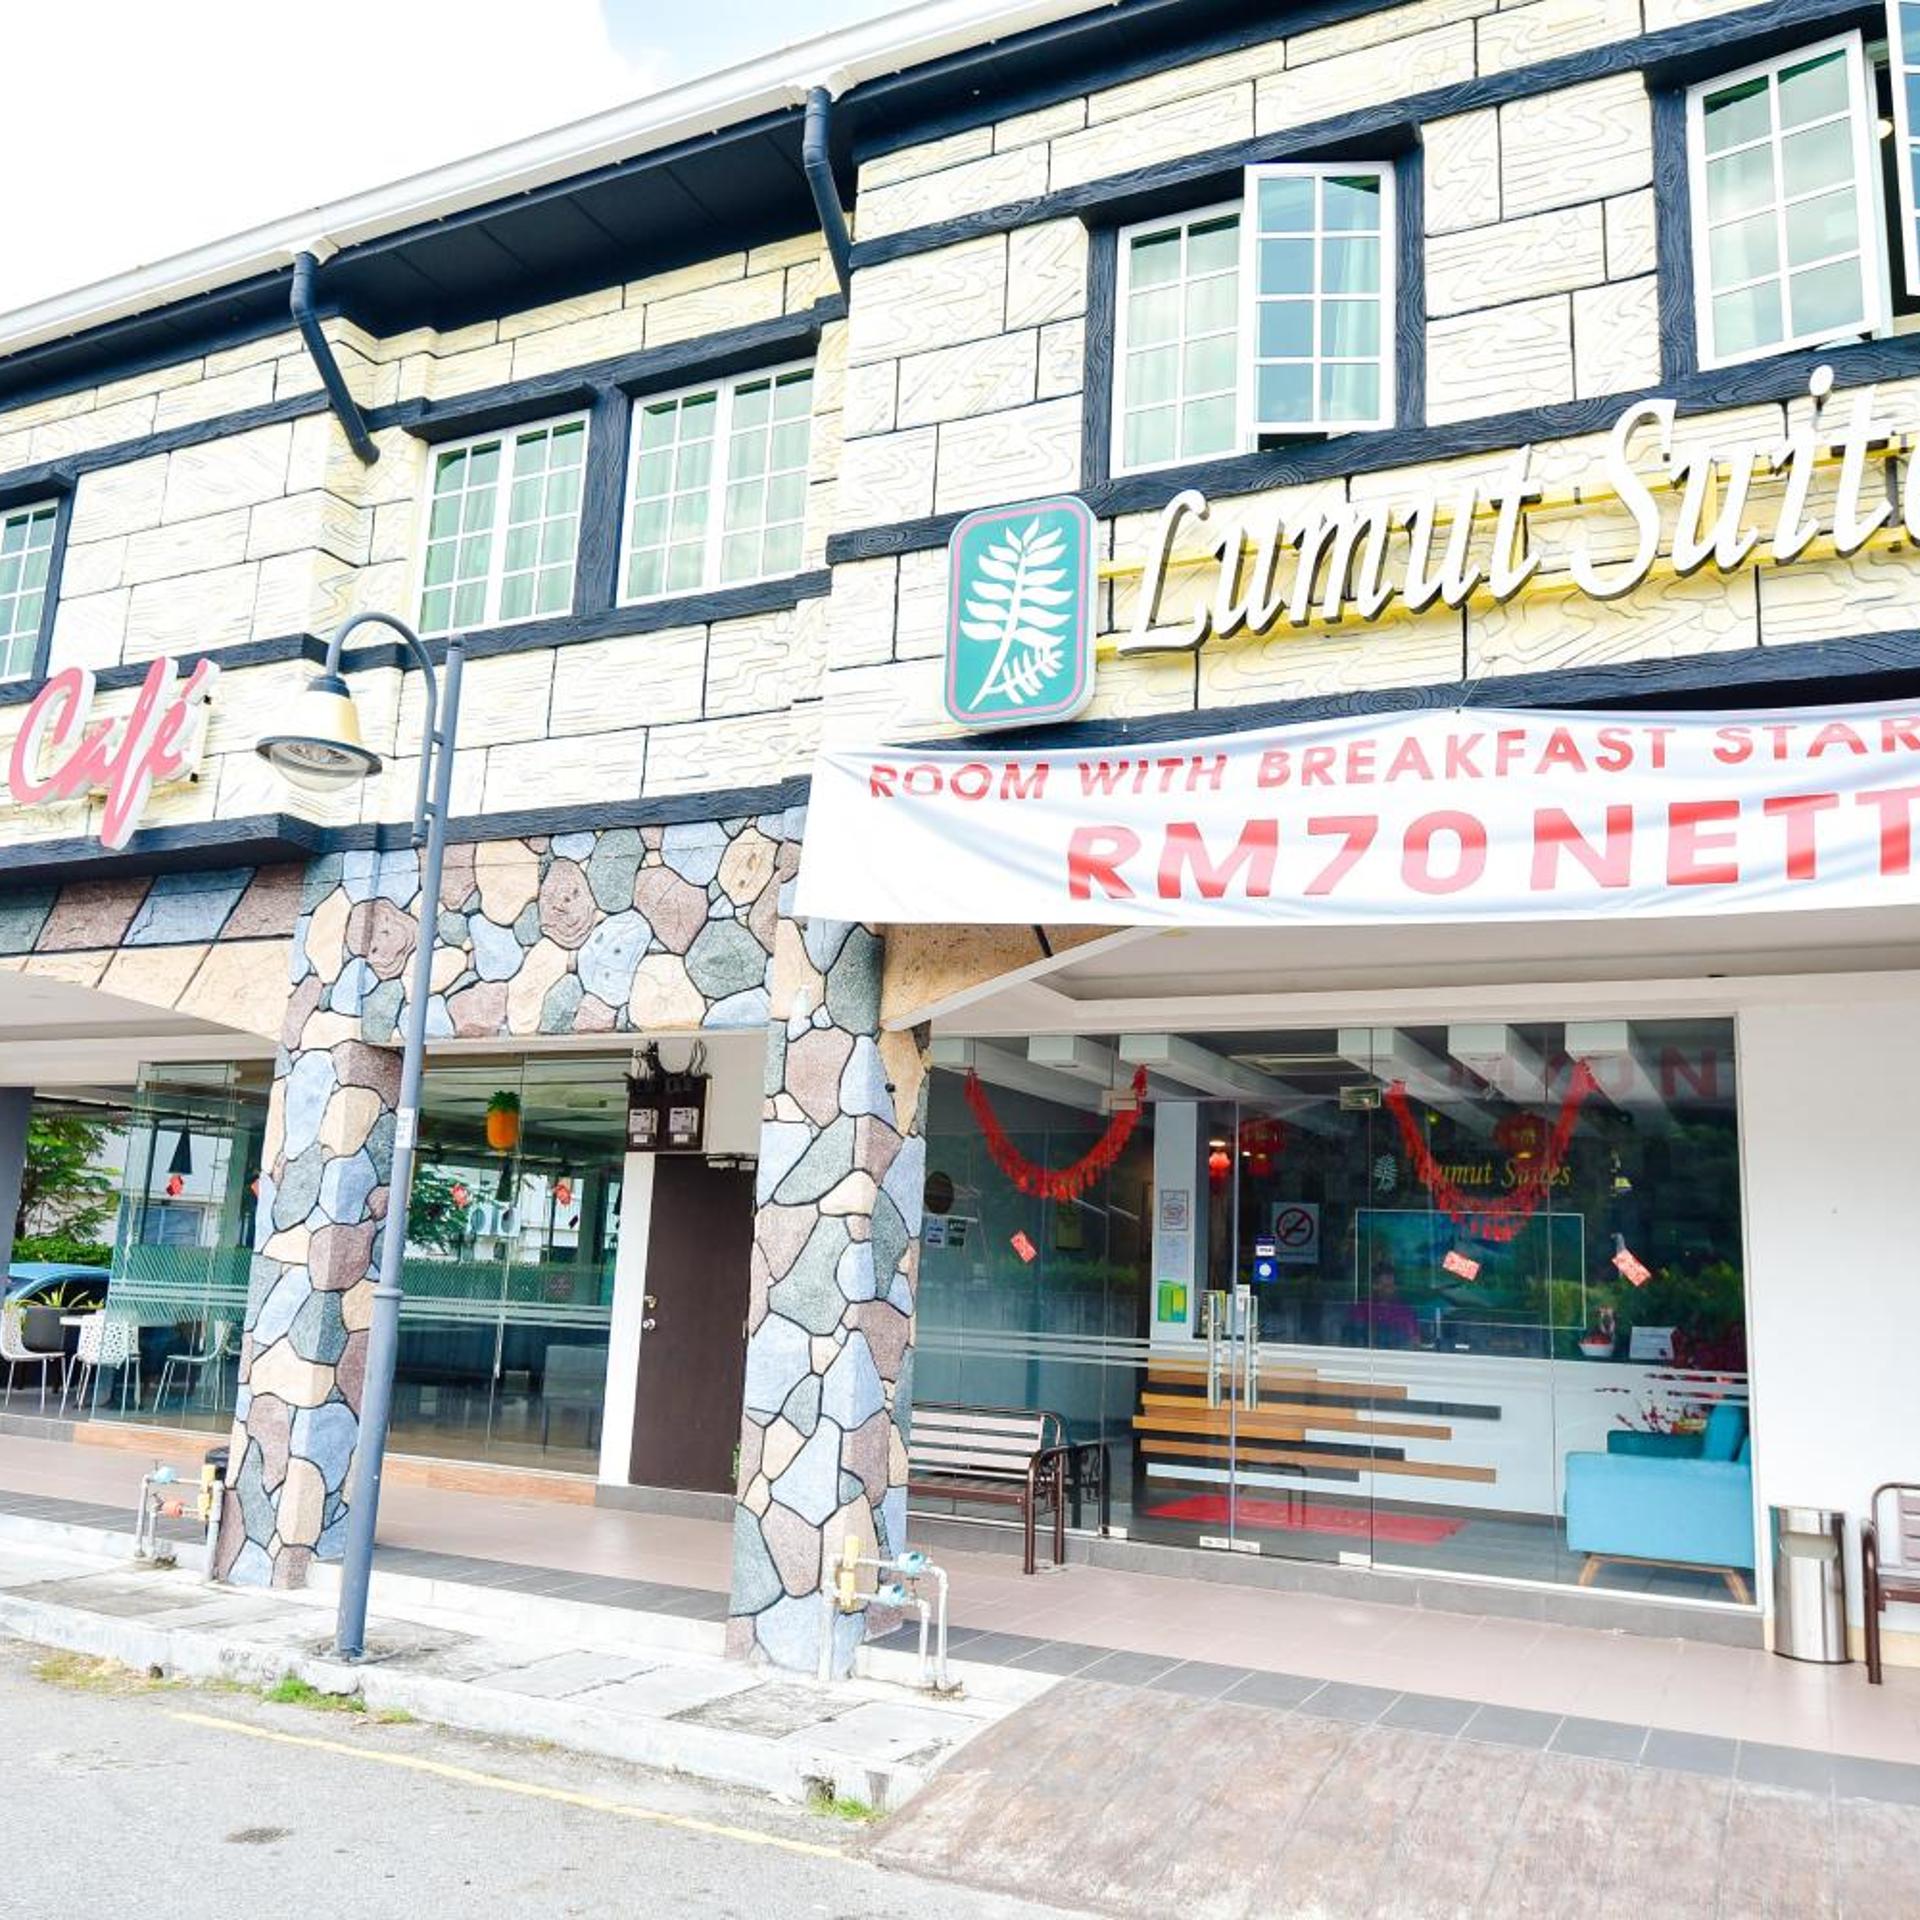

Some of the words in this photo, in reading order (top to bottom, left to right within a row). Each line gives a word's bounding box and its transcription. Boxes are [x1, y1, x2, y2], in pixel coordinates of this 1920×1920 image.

[1118, 443, 1543, 655] Lumut
[9, 656, 216, 848] Café
[869, 762, 1049, 801] ROOM
[1078, 754, 1228, 796] WITH
[1257, 726, 1677, 788] BREAKFAST
[1712, 715, 1920, 765] STAR
[1067, 809, 1488, 900] RM70
[1529, 786, 1920, 891] NETT
